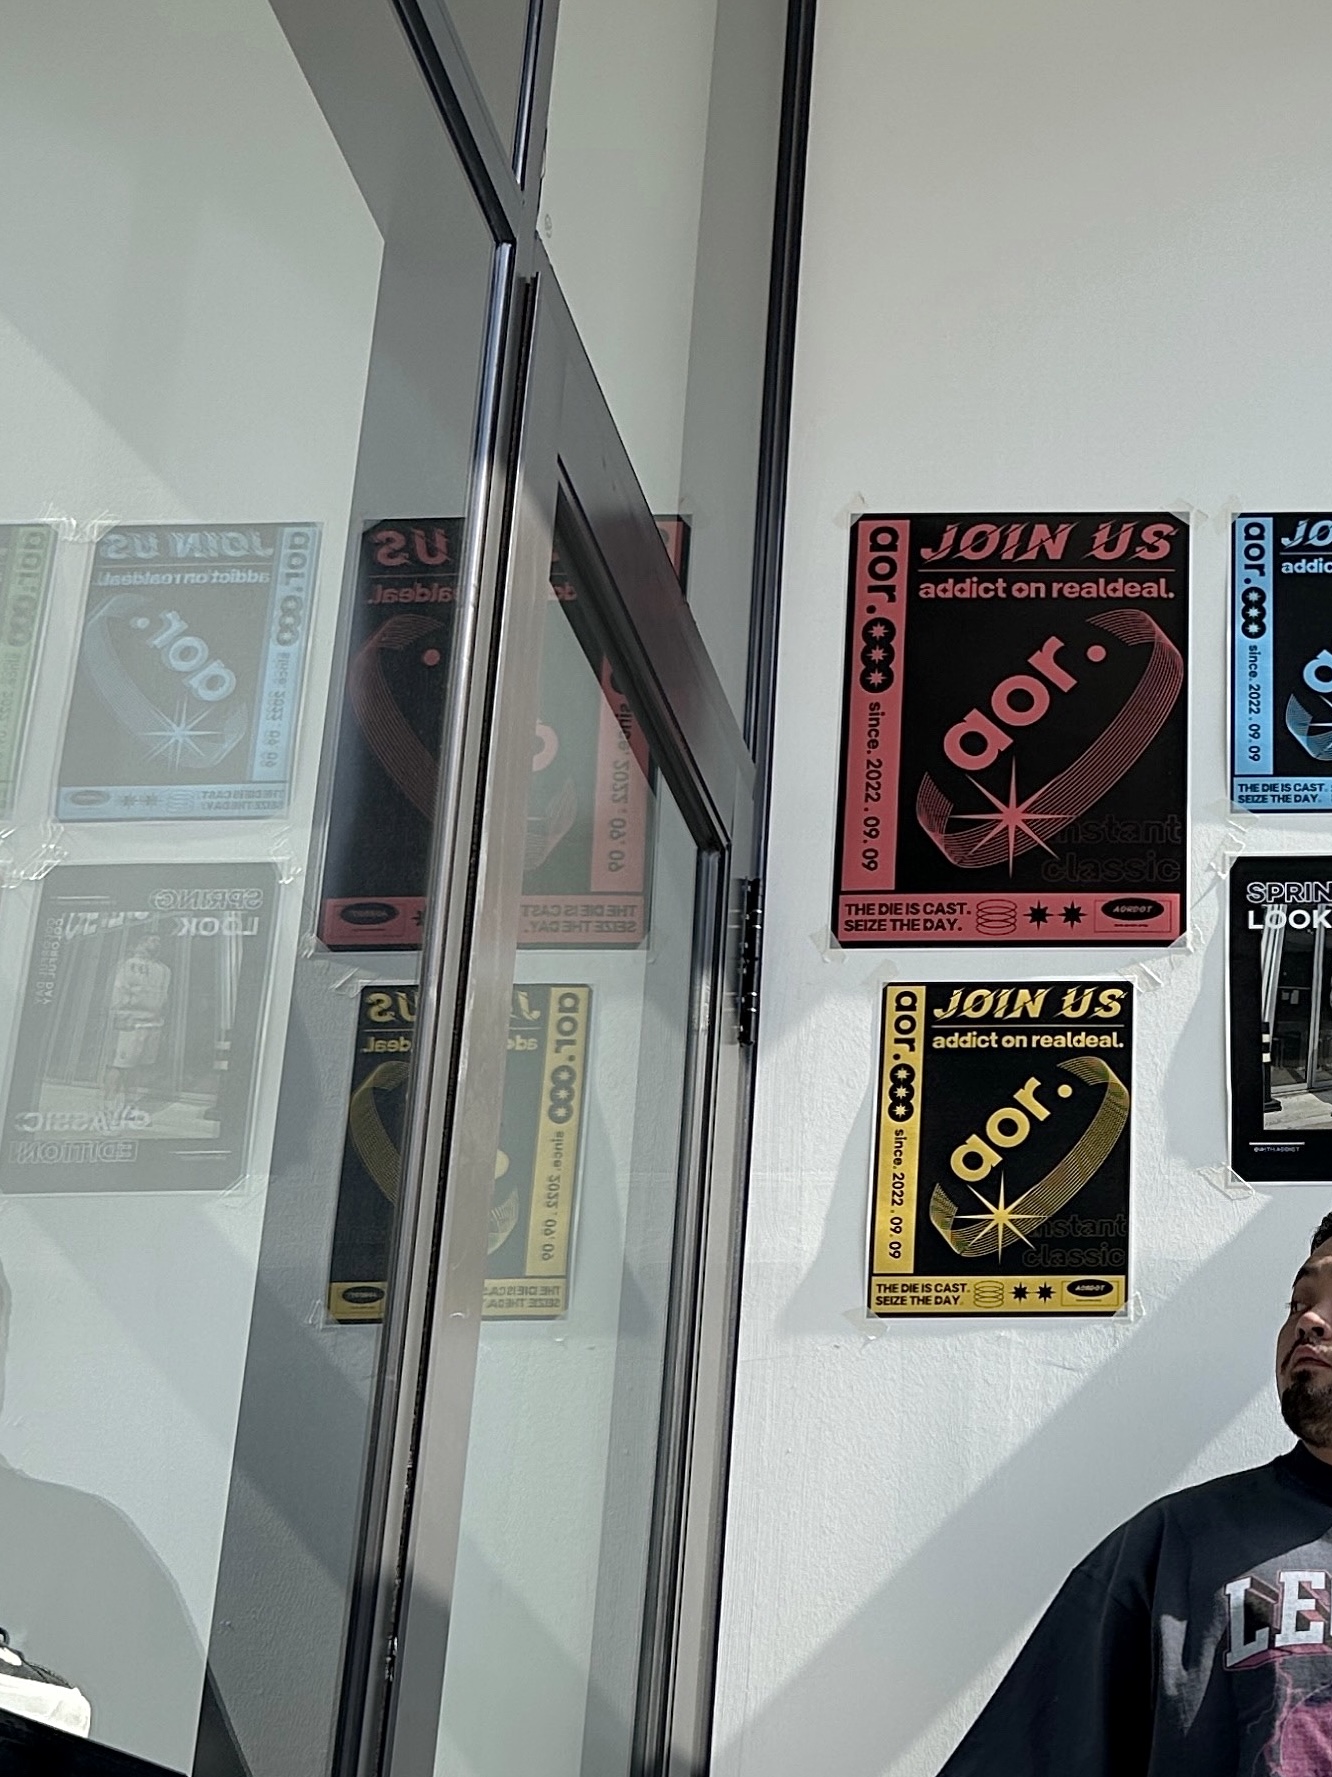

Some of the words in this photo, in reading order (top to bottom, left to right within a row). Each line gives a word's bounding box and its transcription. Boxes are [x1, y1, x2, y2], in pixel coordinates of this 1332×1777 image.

[919, 521, 1078, 563] JOIN
[1083, 520, 1178, 561] US
[1243, 521, 1266, 585] aor.
[867, 526, 899, 615] aor.
[919, 578, 1007, 599] addict
[1012, 581, 1046, 599] on
[1051, 577, 1175, 599] realdeal.
[944, 636, 1106, 771] aor.
[1248, 745, 1261, 762] 09
[1238, 783, 1260, 792] THE
[1262, 783, 1279, 792] DIE
[1281, 783, 1291, 792] IS
[1238, 794, 1268, 803] SEIZE
[1270, 794, 1292, 803] THE
[1050, 814, 1182, 845] nstant
[862, 849, 878, 871] 09
[845, 903, 875, 916] THE
[878, 903, 904, 915] DIE
[906, 903, 920, 915] IS
[1248, 909, 1332, 929] LOOK
[844, 919, 886, 932] SEIZE
[890, 918, 920, 931] THE
[933, 987, 1050, 1021] JOIN
[1051, 986, 1128, 1020] US
[892, 990, 918, 1061] aor.
[932, 1032, 998, 1049] addict
[1001, 1034, 1027, 1048] on
[1031, 1032, 1124, 1048] realdeal.
[950, 1076, 1073, 1182] aor.
[1030, 1213, 1127, 1237] nstant
[888, 1241, 901, 1260] 09
[876, 1283, 899, 1293] THE
[901, 1283, 919, 1293] DIE
[921, 1283, 932, 1293] IS
[875, 1295, 907, 1306] SEIZE
[909, 1295, 932, 1305] THE
